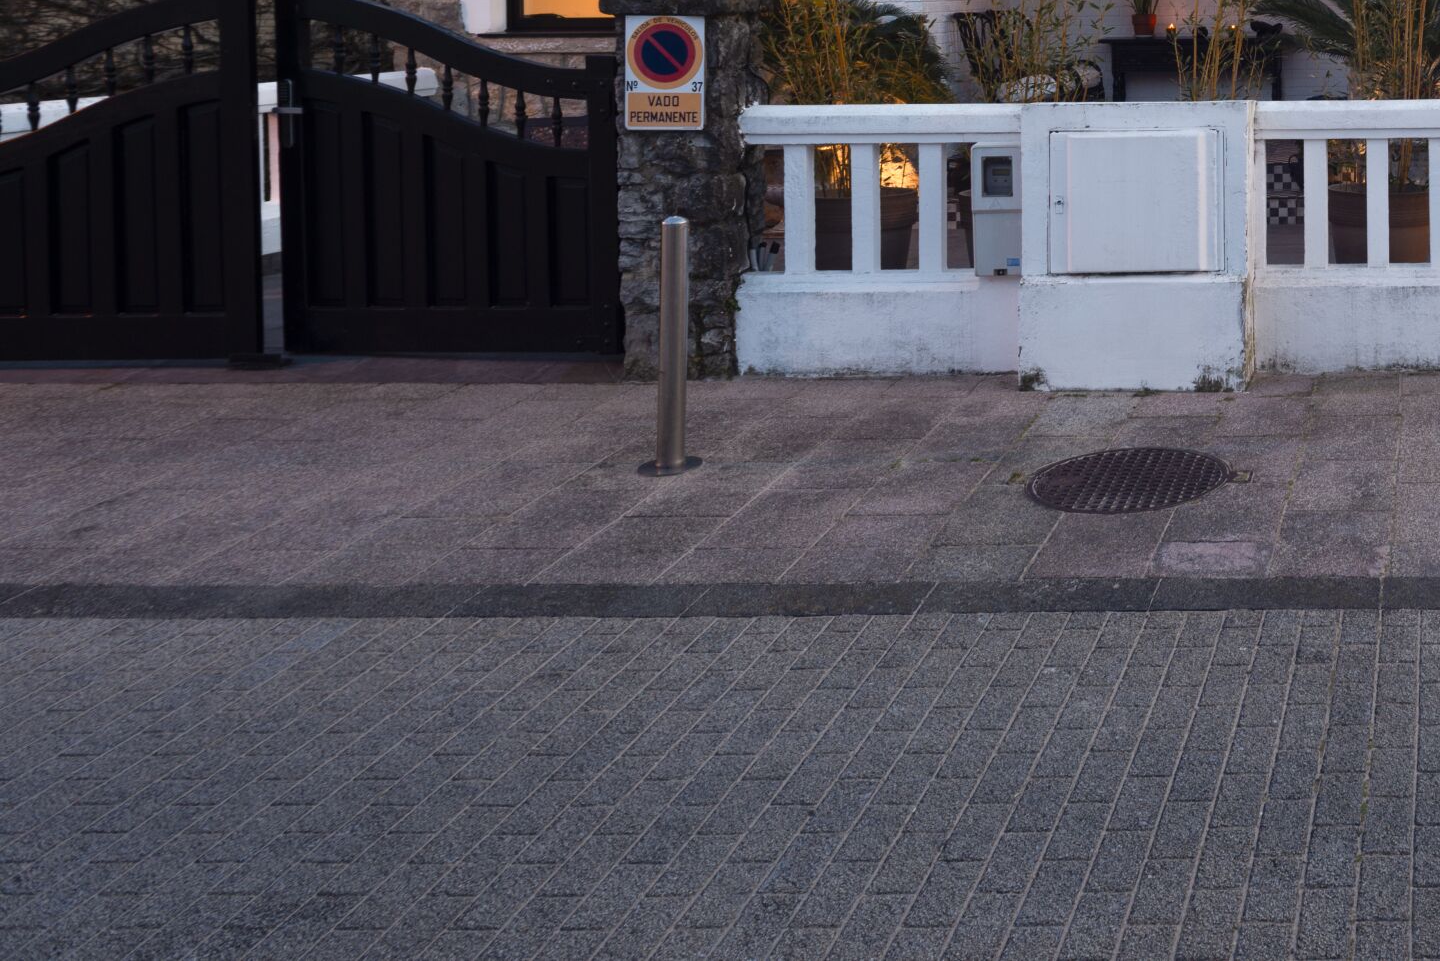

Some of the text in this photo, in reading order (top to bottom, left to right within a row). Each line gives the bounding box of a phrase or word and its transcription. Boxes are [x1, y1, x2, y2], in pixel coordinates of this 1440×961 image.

[691, 81, 703, 92] 37
[648, 95, 680, 107] VADO
[630, 111, 698, 123] PERMANENTE
